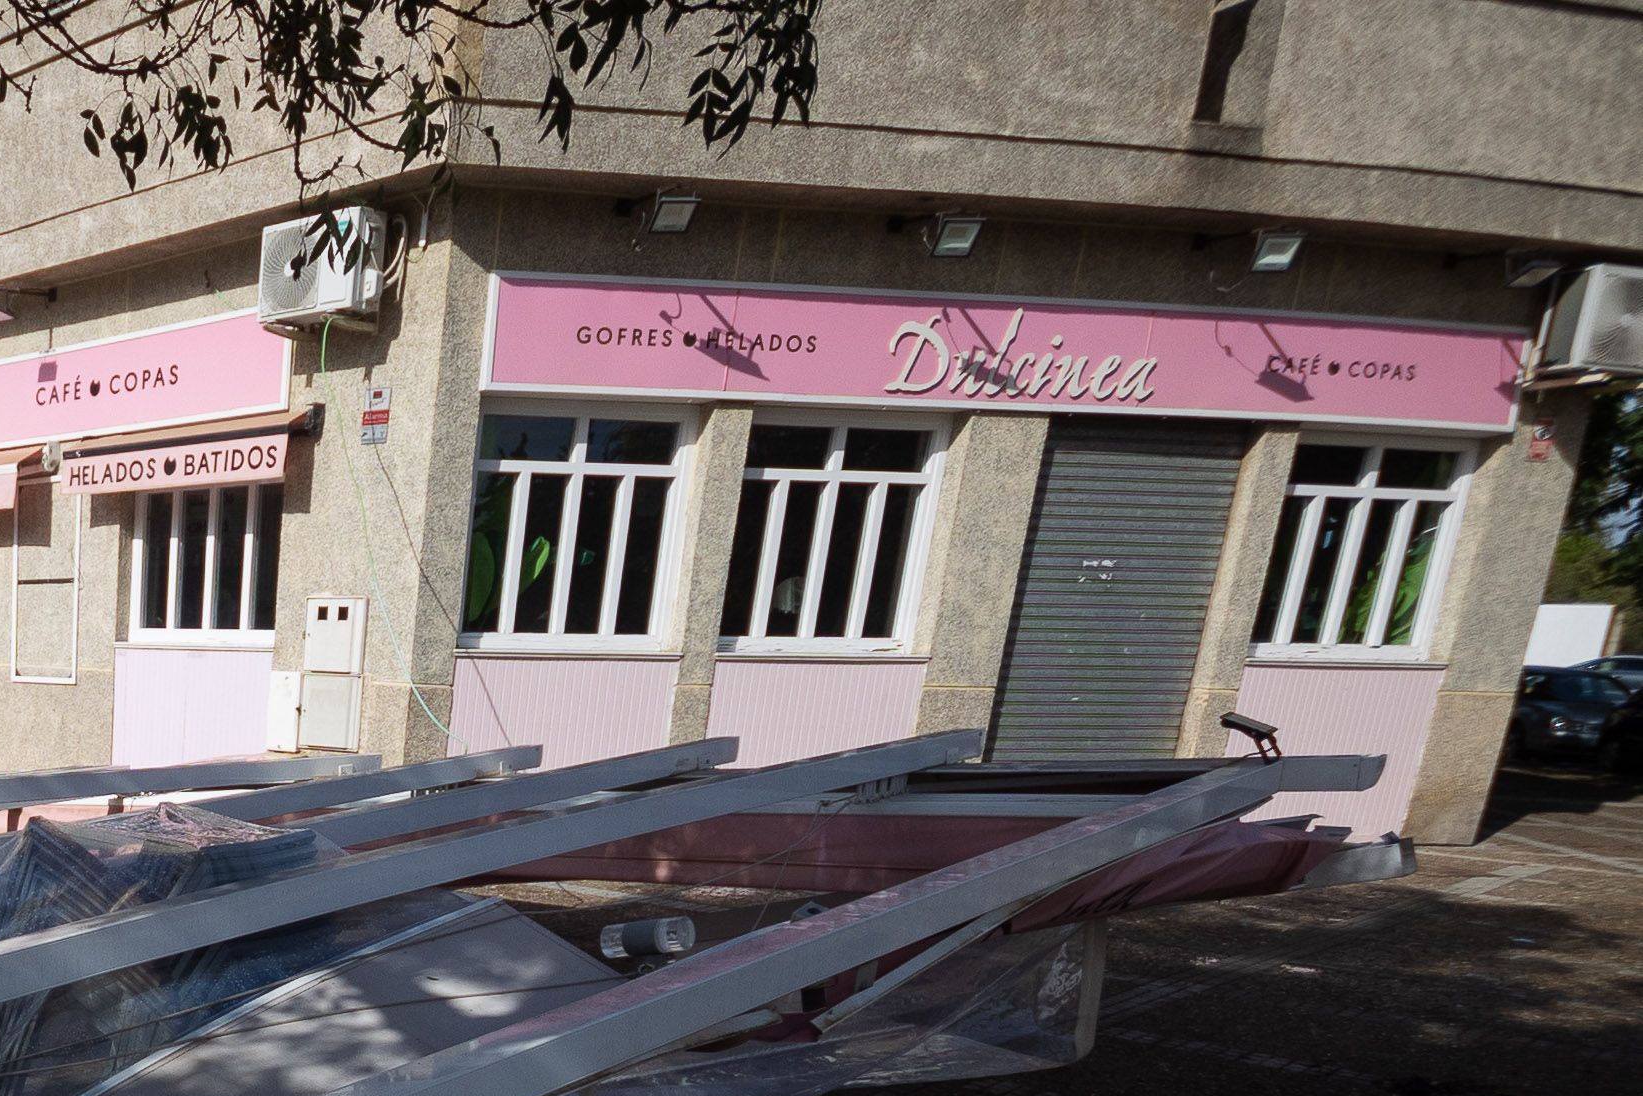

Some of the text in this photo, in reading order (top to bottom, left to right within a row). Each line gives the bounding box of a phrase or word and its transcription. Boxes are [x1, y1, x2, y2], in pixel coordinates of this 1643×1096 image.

[576, 326, 818, 353] GOFRES HELADOS
[884, 307, 1158, 401] Dulcinea
[35, 364, 179, 406] CAFÉ COPAS
[1267, 353, 1417, 381] CAFÉ COPAS
[69, 445, 278, 487] HELADOS BATIDOS
